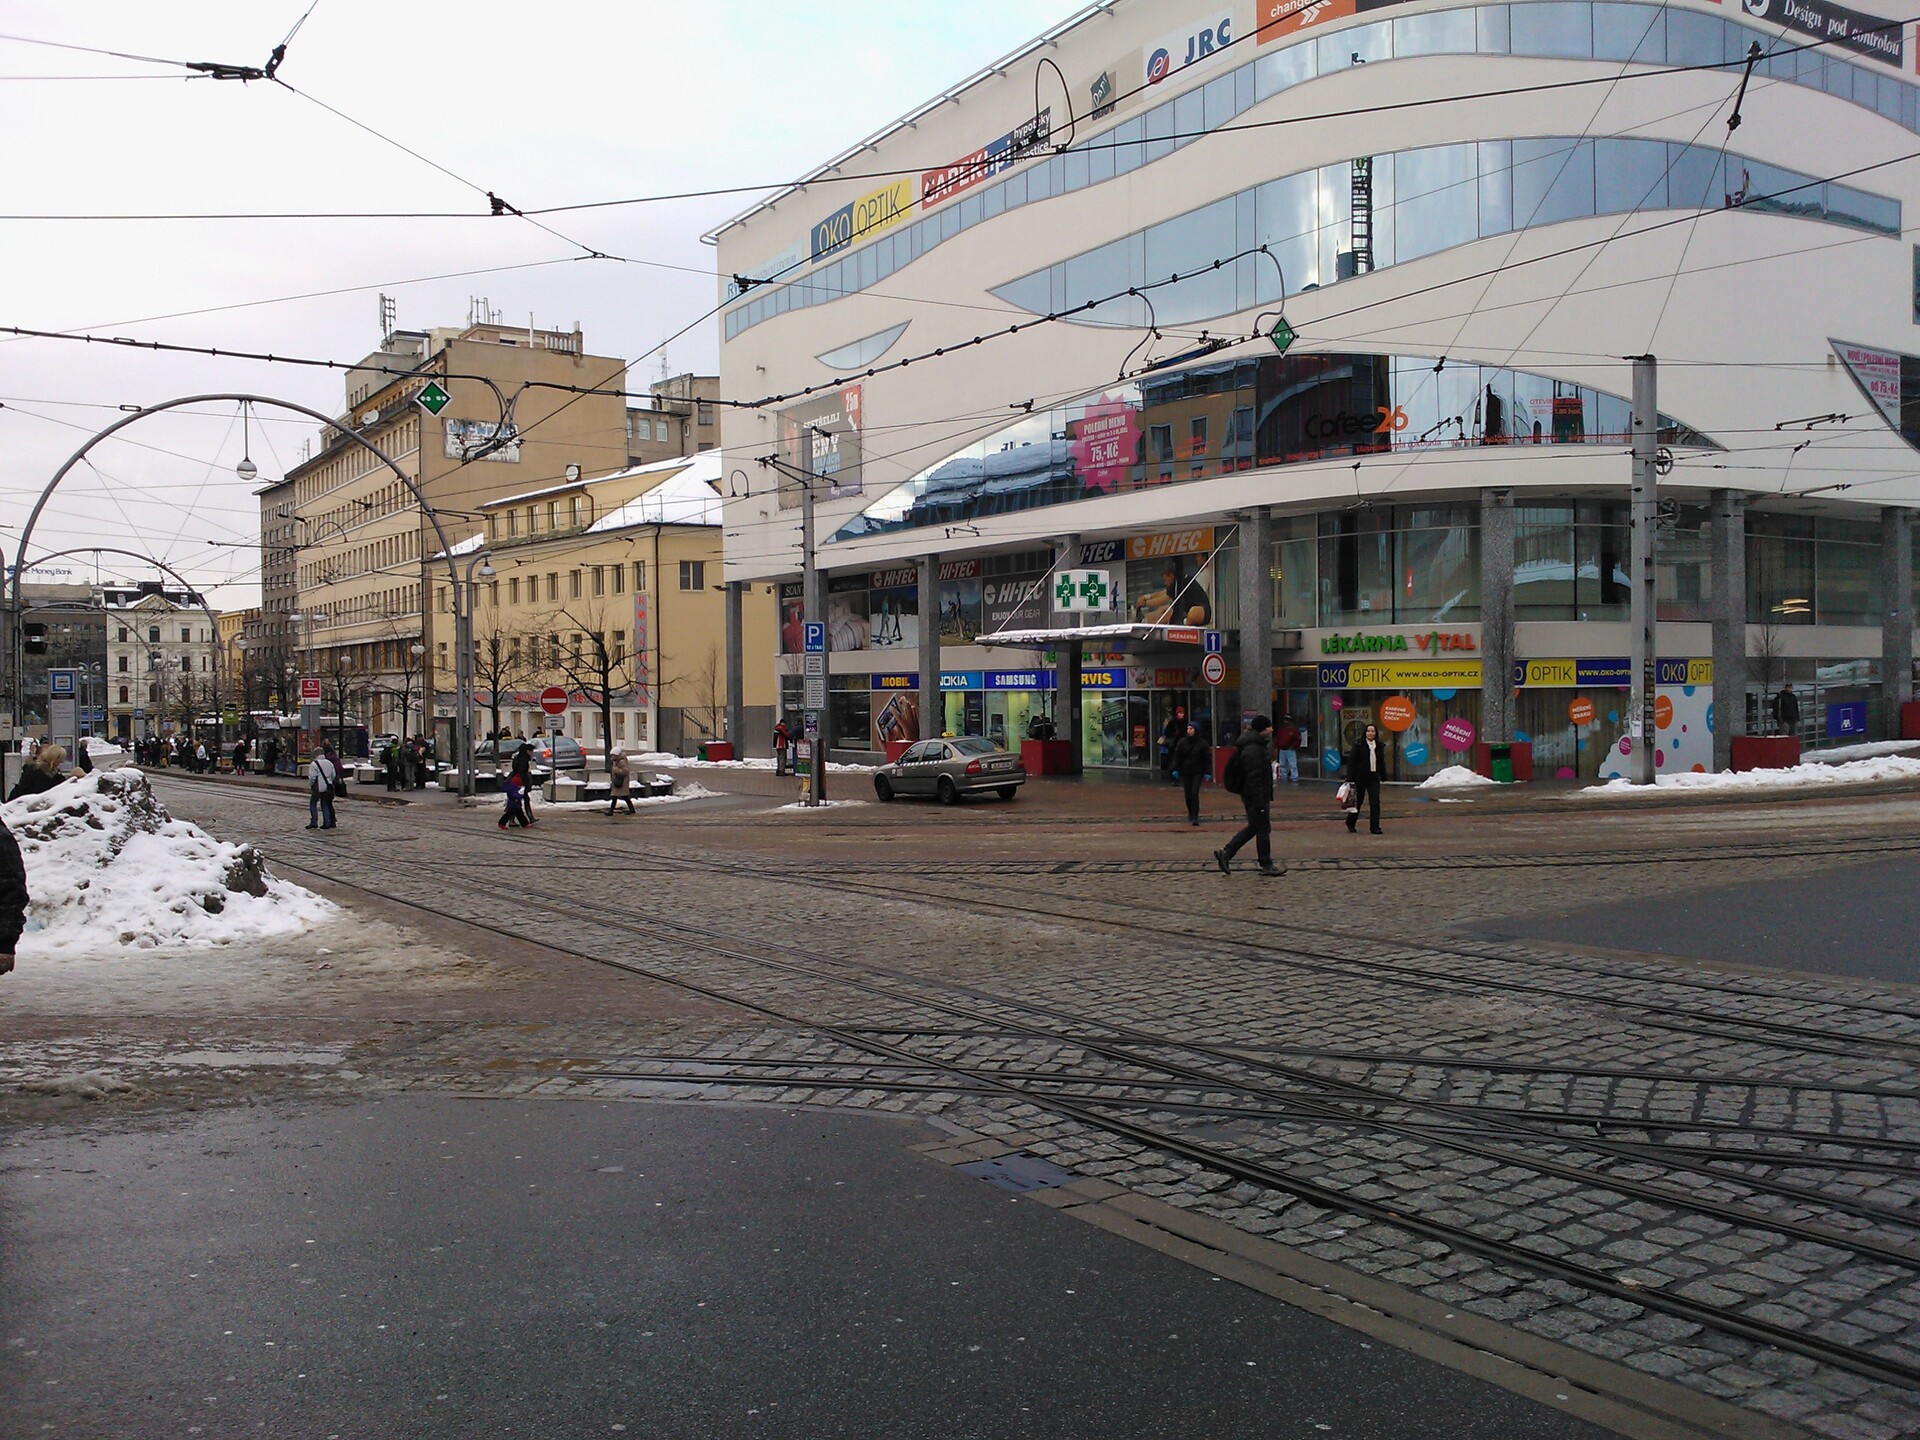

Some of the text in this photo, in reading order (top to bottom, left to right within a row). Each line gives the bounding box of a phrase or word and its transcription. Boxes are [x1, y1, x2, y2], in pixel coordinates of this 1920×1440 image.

[1784, 0, 1900, 57] Design pod controlou
[1184, 18, 1231, 64] JRC
[1014, 113, 1050, 139] hypotky
[818, 183, 901, 256] OKO OPTIK
[31, 567, 55, 576] Money
[55, 568, 73, 576] Bank
[785, 584, 802, 597] SCAN
[992, 611, 1011, 621] ENJOY
[1024, 609, 1041, 619] GEAR
[808, 625, 820, 643] P
[1321, 632, 1407, 654] LÉKÁRNA
[1081, 672, 1113, 685] RVIS
[1157, 671, 1184, 685] BILLA
[1321, 668, 1478, 684] OKO OPTIK WWW.OKO-OPTIK.CZ
[1531, 666, 1631, 681] OPTIK WWW.OKO-OPTI
[1662, 663, 1713, 681] OKO OPTI
[881, 676, 910, 687] MOBIL
[995, 673, 1037, 686] SAMSUNG
[1443, 731, 1467, 743] ZRAKU
[1445, 724, 1472, 737] MĚŘENÍ
